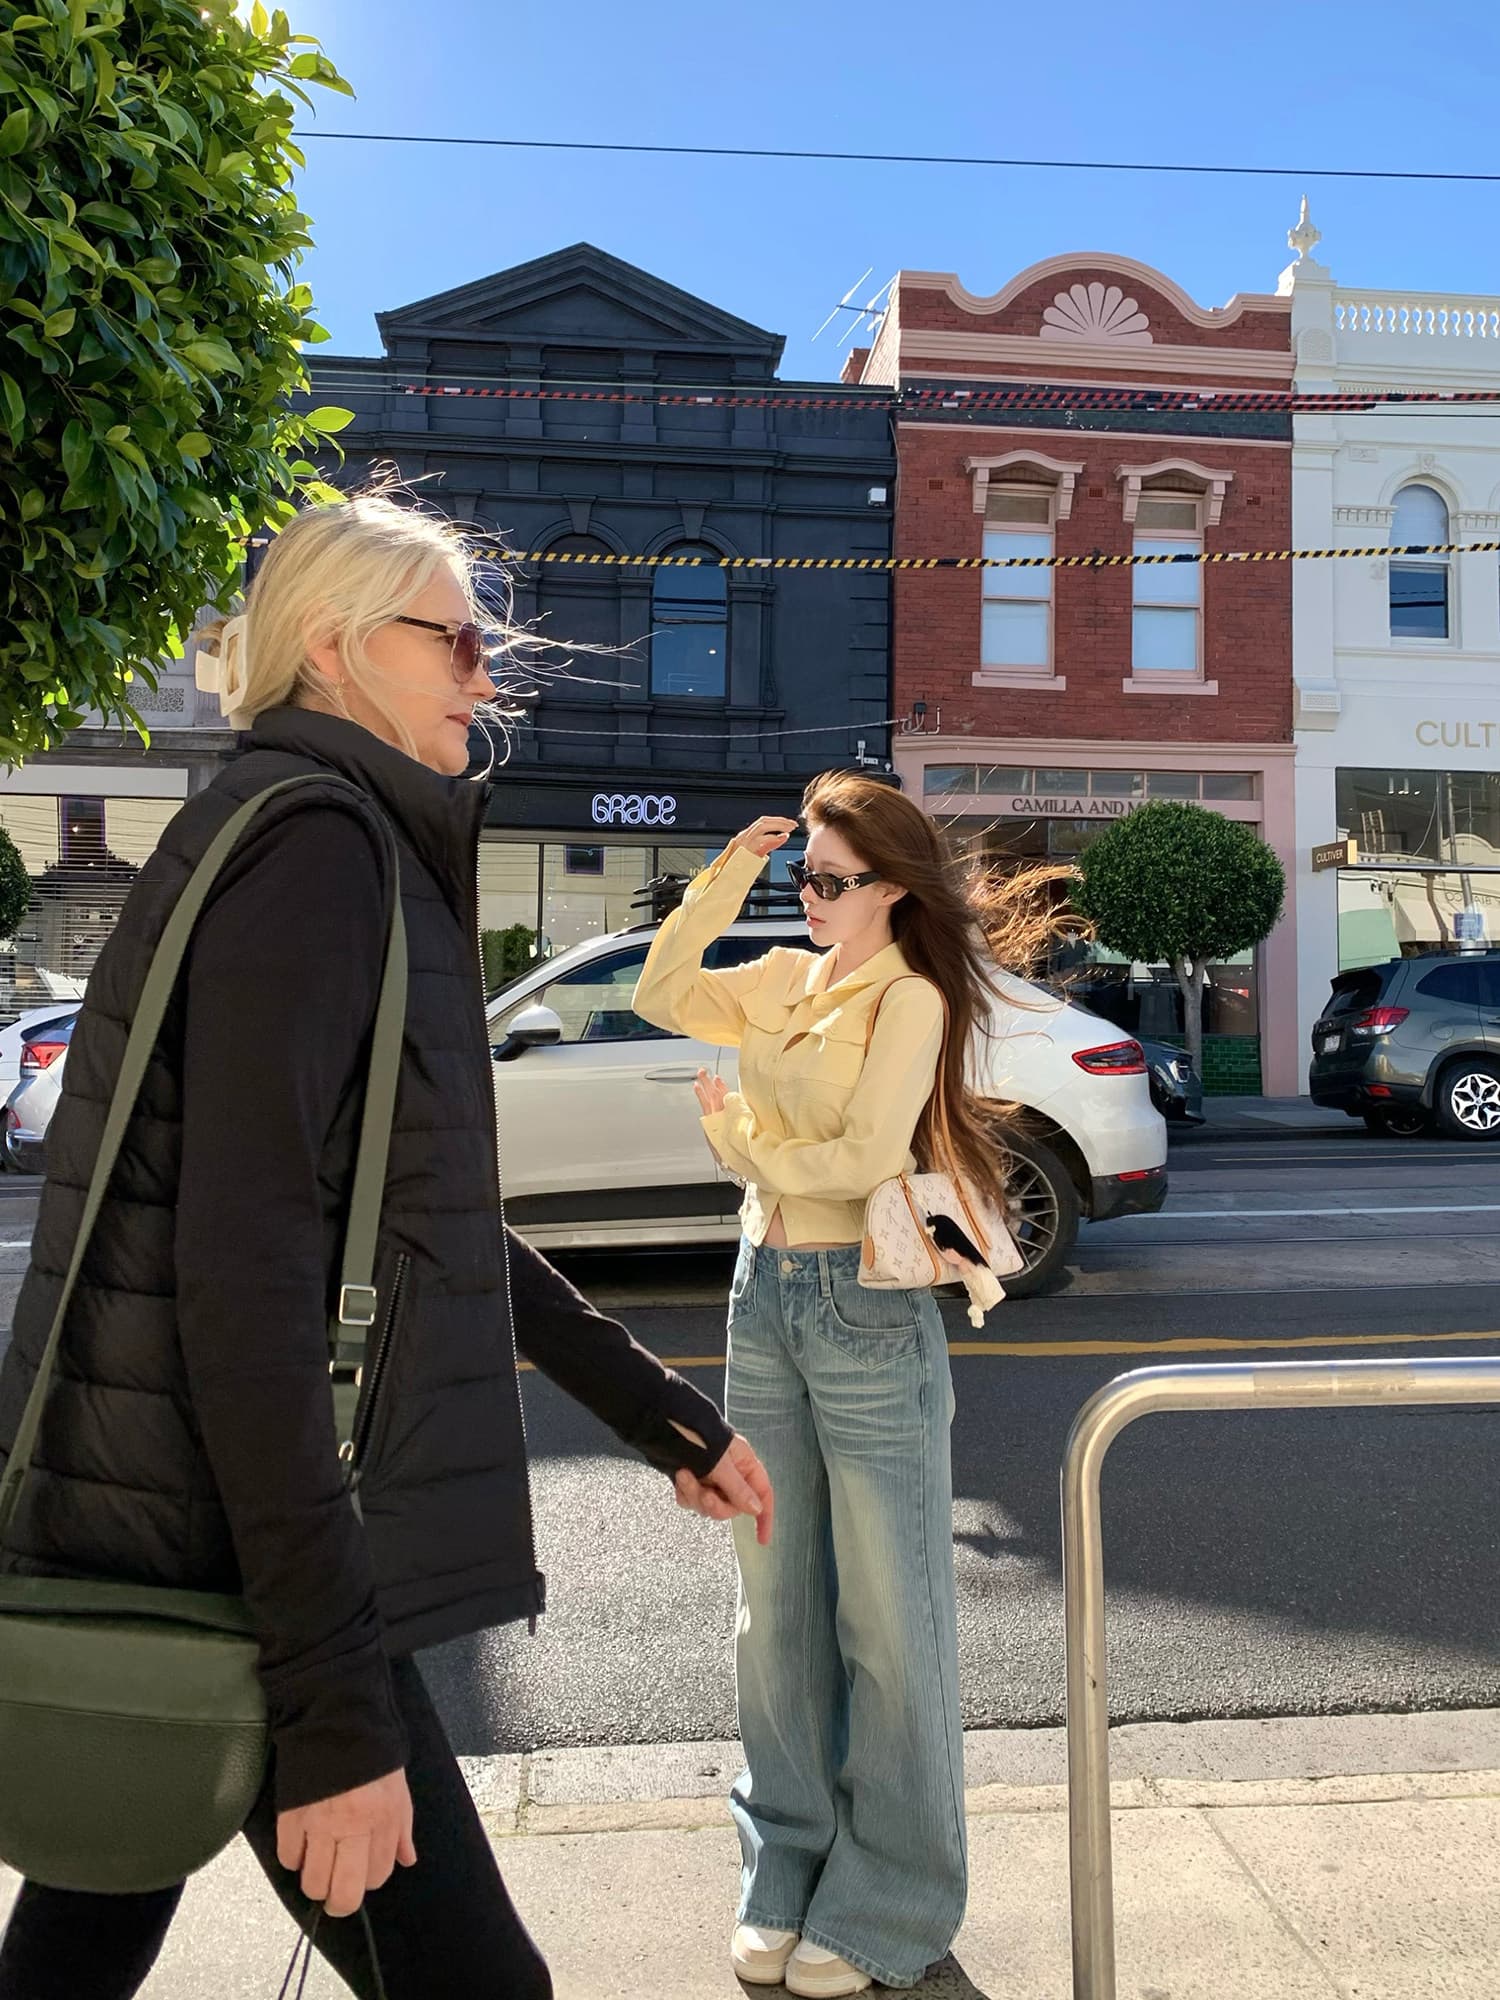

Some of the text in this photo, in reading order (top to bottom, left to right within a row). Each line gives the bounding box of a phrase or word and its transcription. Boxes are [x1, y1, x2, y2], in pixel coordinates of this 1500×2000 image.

[1012, 798, 1084, 815] CAMILLA
[1088, 800, 1125, 815] AND
[1315, 848, 1344, 864] CULTIVER
